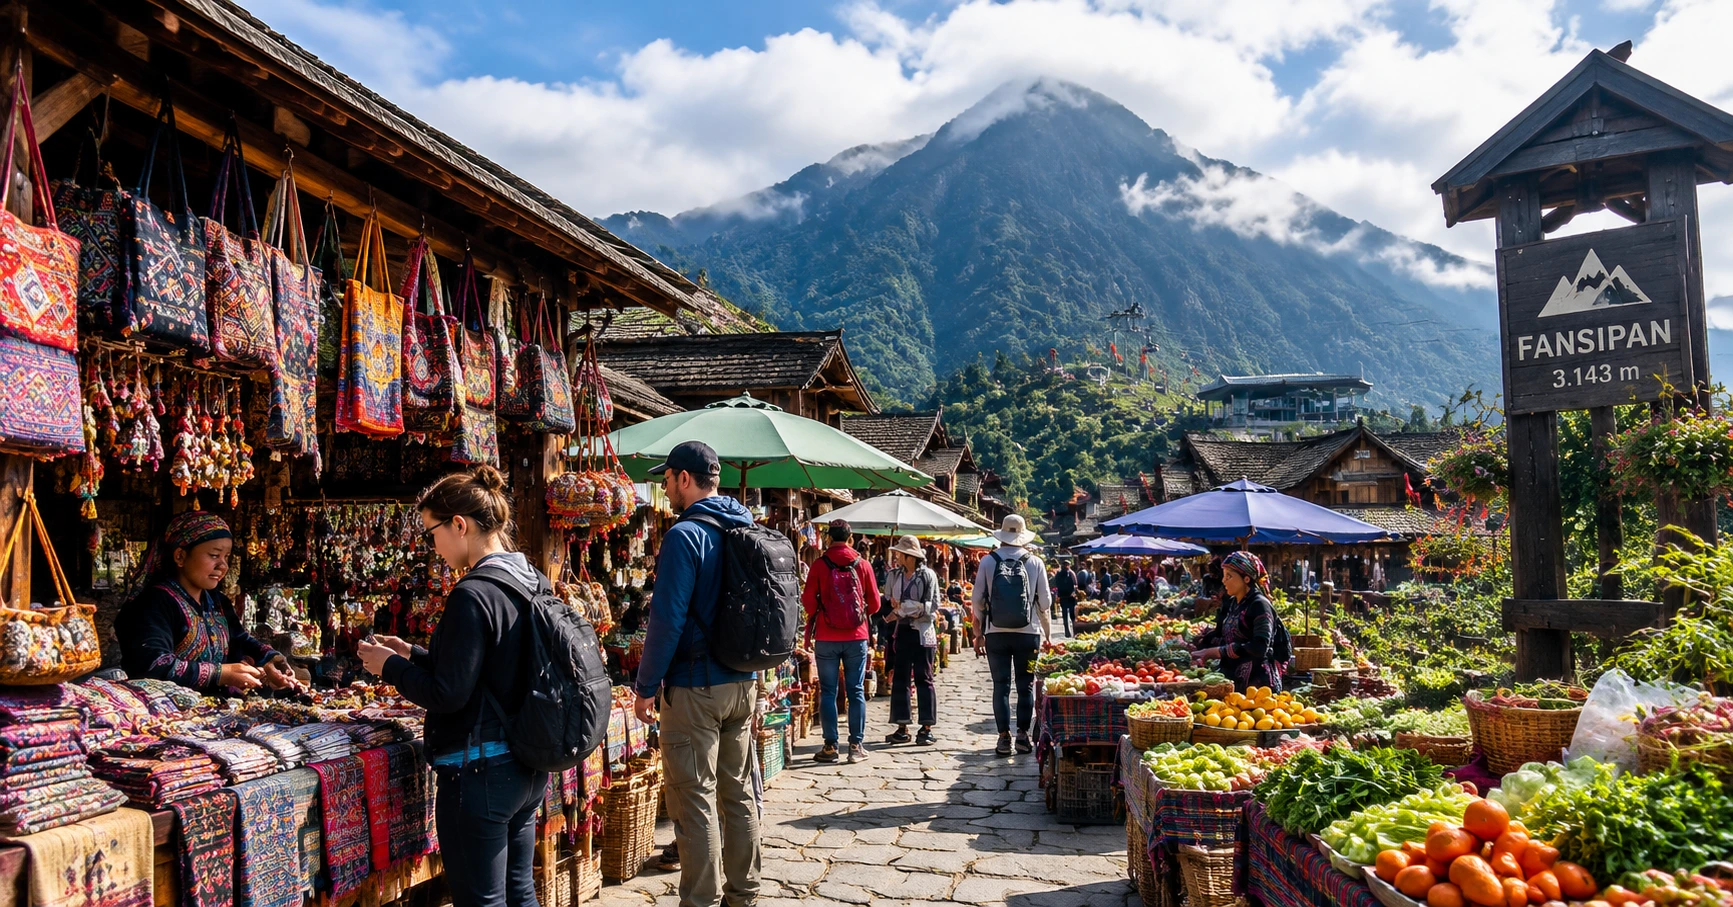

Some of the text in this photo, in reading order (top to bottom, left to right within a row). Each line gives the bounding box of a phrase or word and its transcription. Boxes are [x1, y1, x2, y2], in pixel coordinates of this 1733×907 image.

[1518, 319, 1671, 361] FANSIPAN
[1552, 363, 1640, 388] 3.143 m
